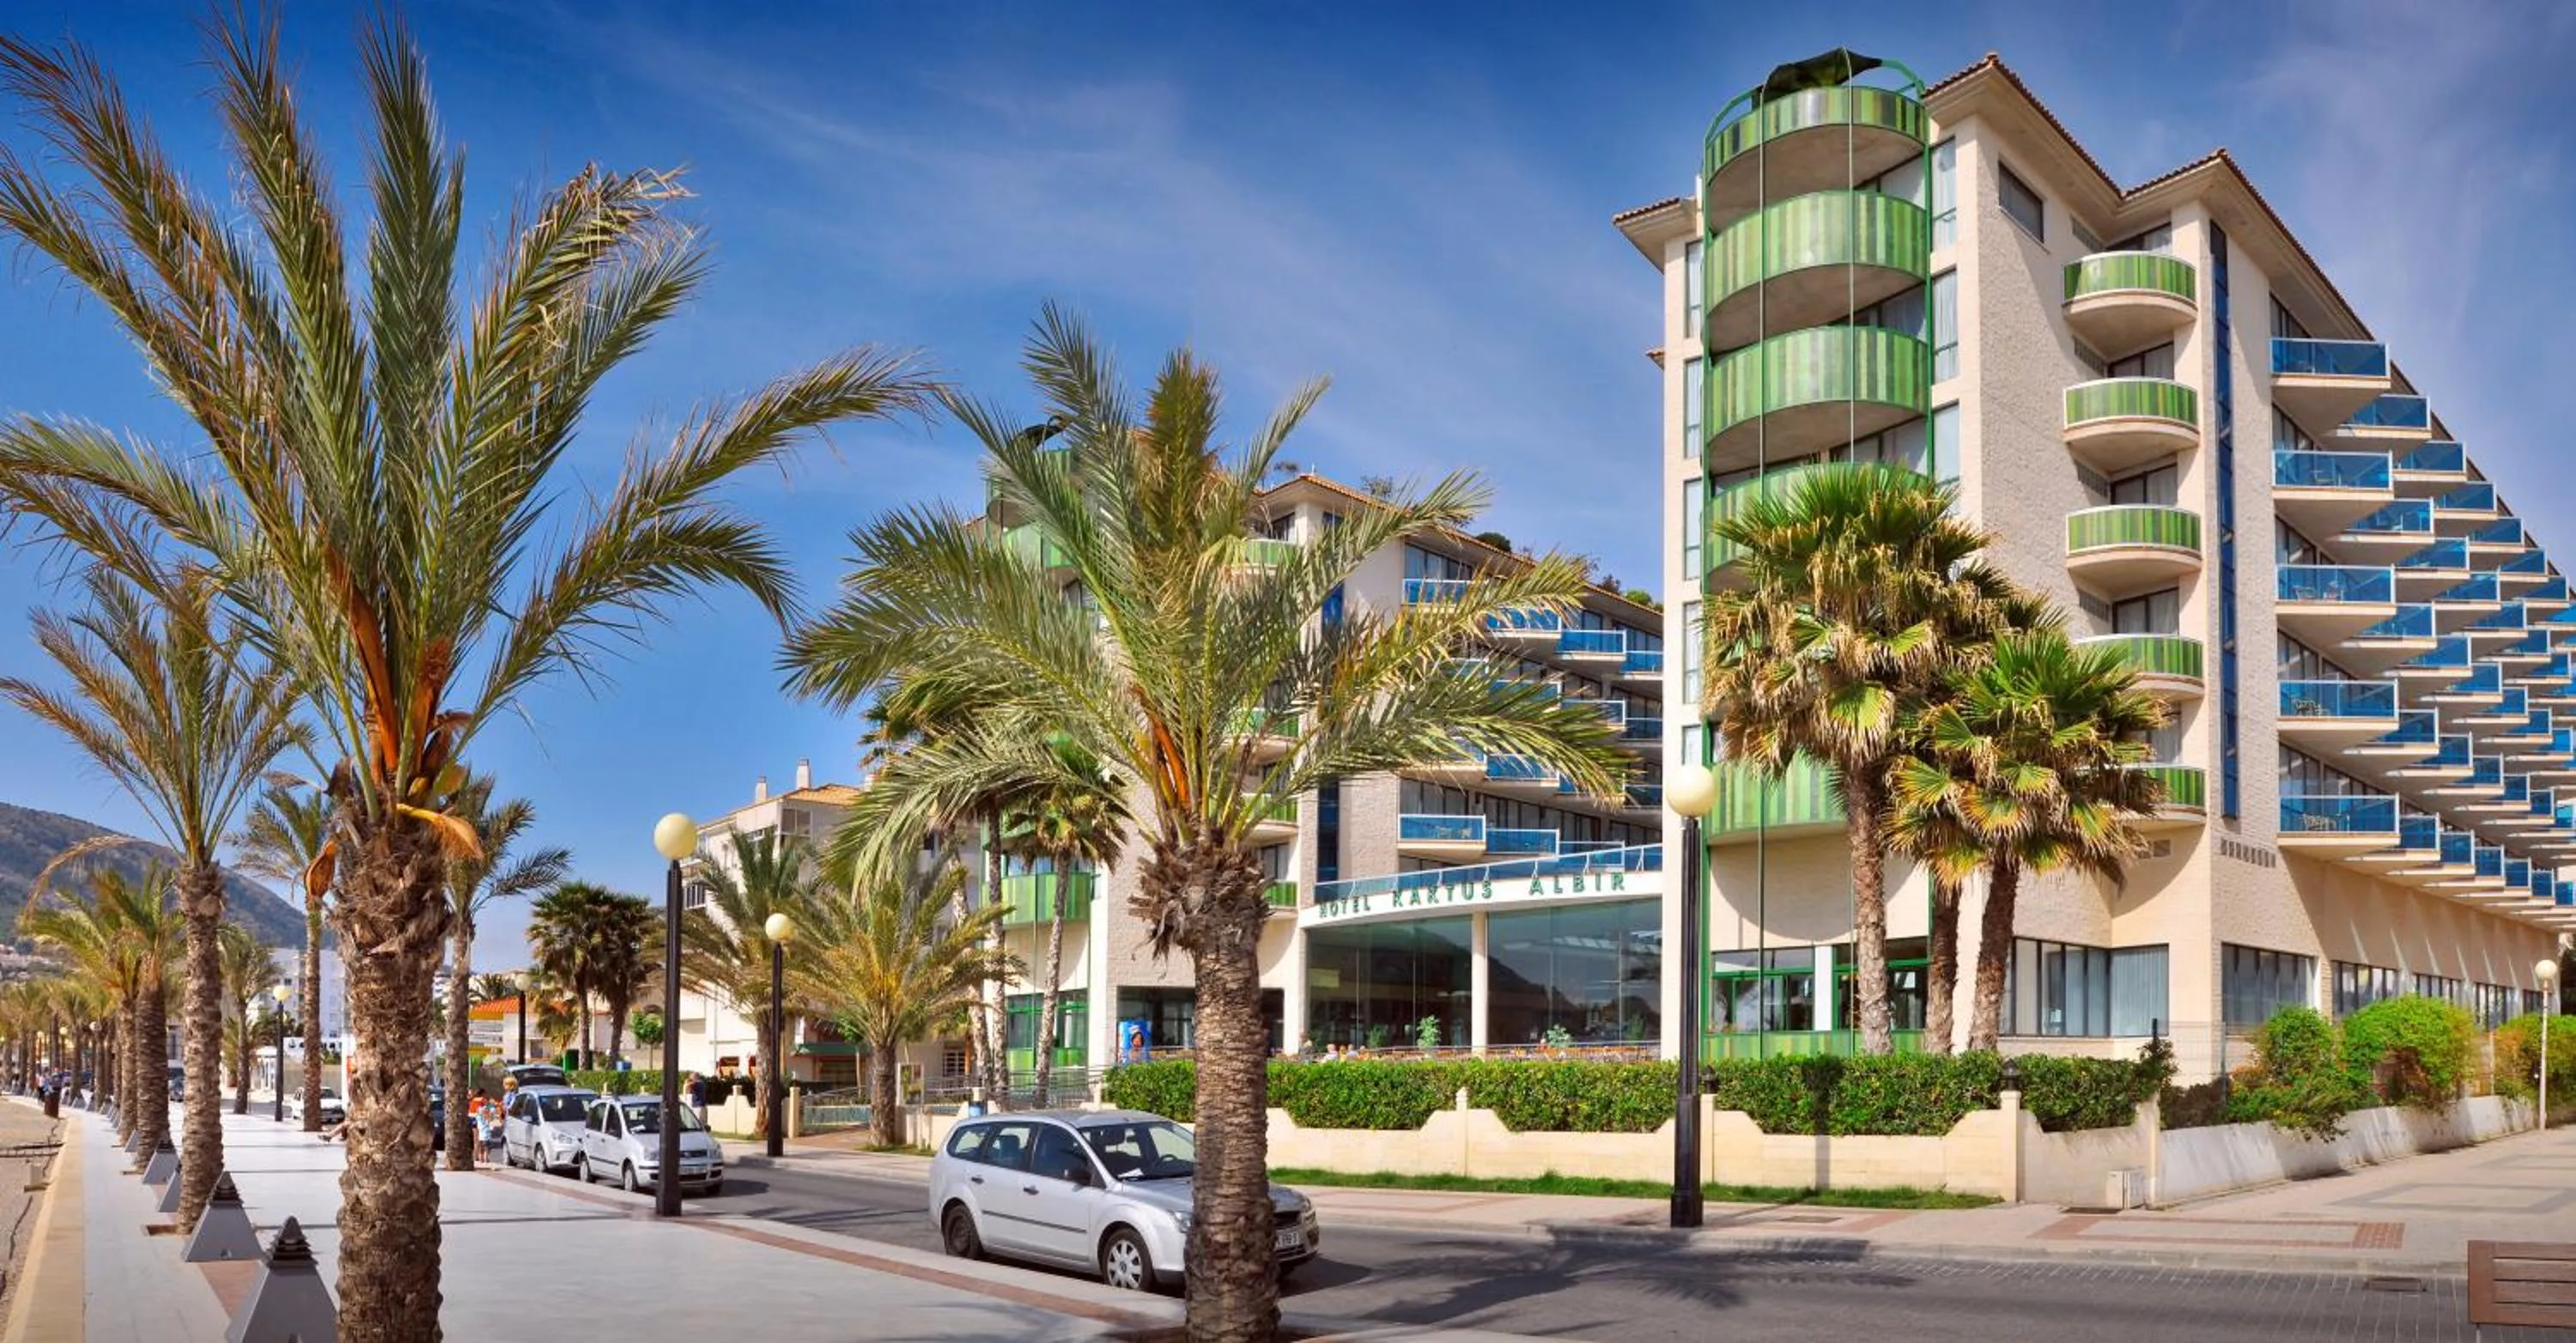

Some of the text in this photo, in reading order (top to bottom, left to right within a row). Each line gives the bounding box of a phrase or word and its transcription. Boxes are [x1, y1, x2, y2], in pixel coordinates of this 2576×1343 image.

[1319, 872, 1625, 918] HOTEL KAKTUS ALBIR
